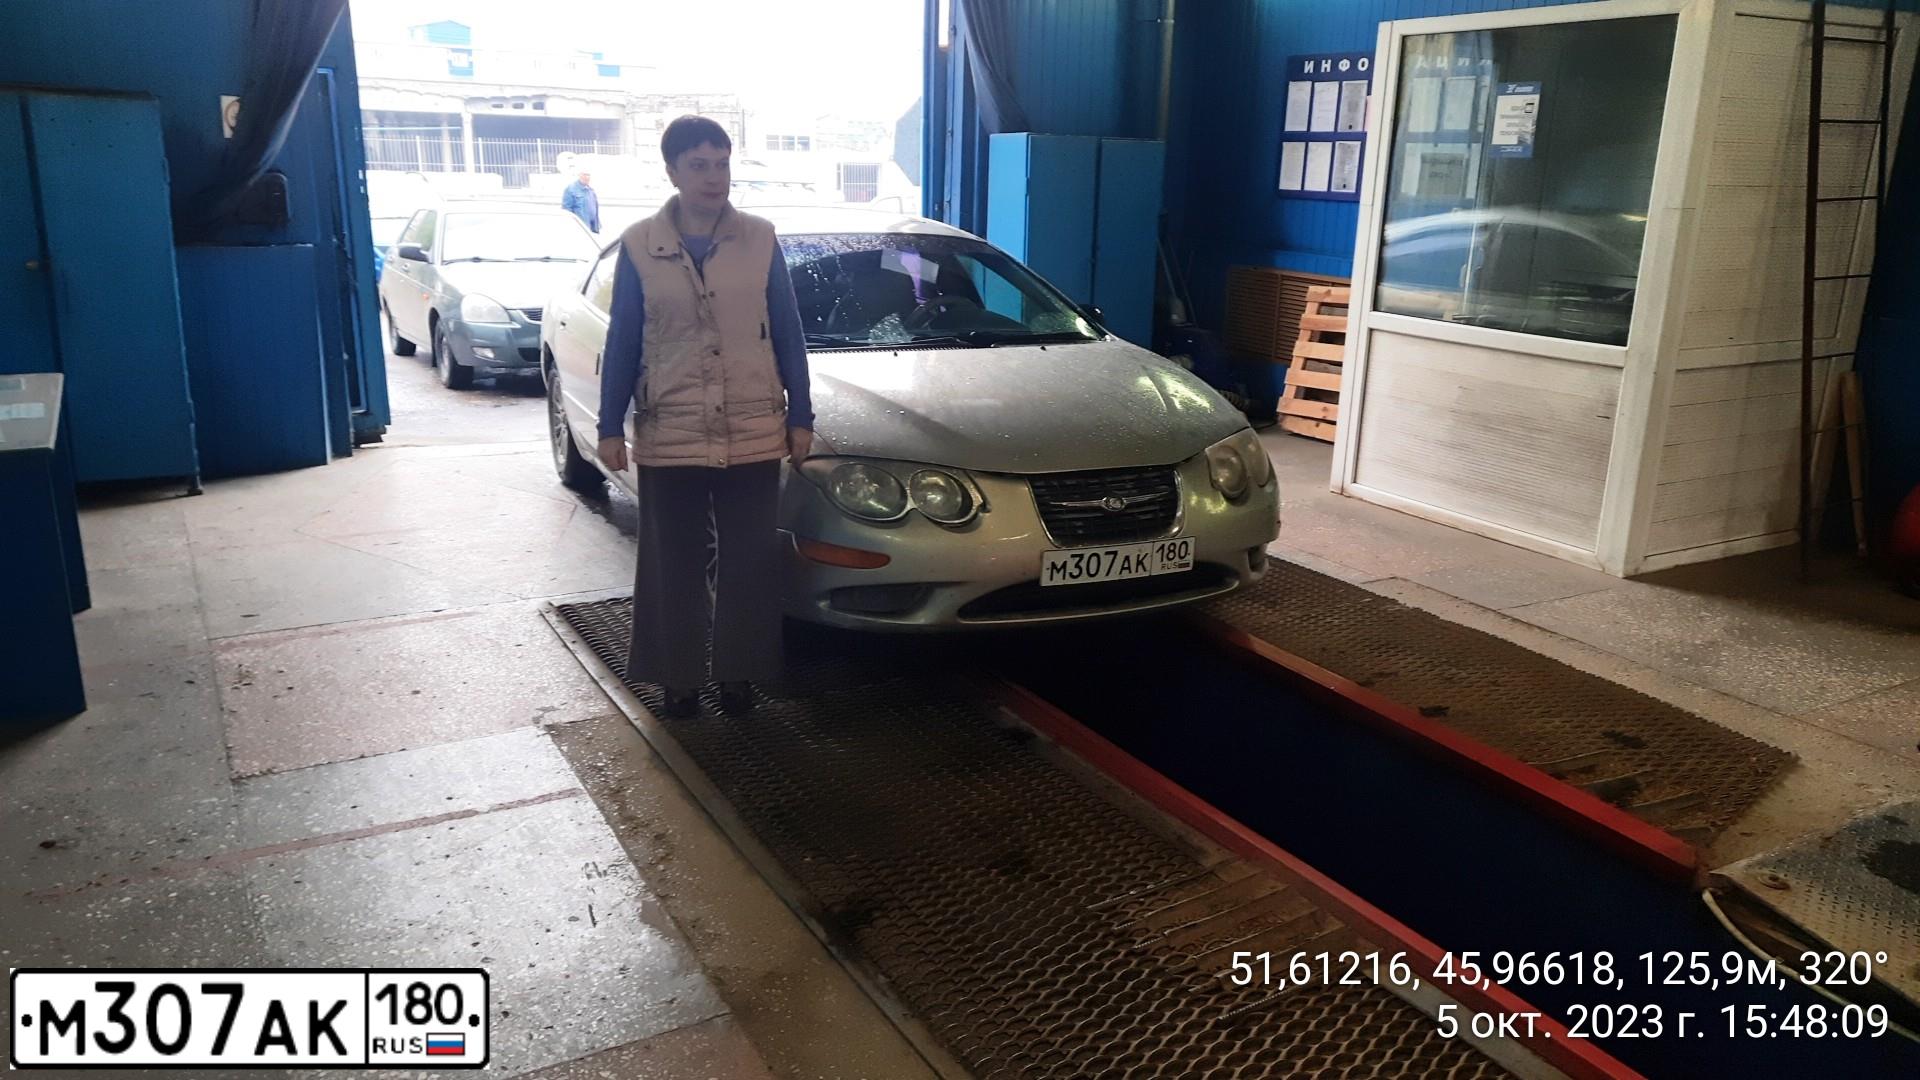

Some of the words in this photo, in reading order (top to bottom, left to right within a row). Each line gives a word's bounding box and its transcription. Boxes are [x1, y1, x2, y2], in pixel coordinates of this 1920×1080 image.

[1048, 550, 1150, 582] М307АК
[1155, 540, 1190, 563] 180
[1160, 562, 1179, 571] RUS
